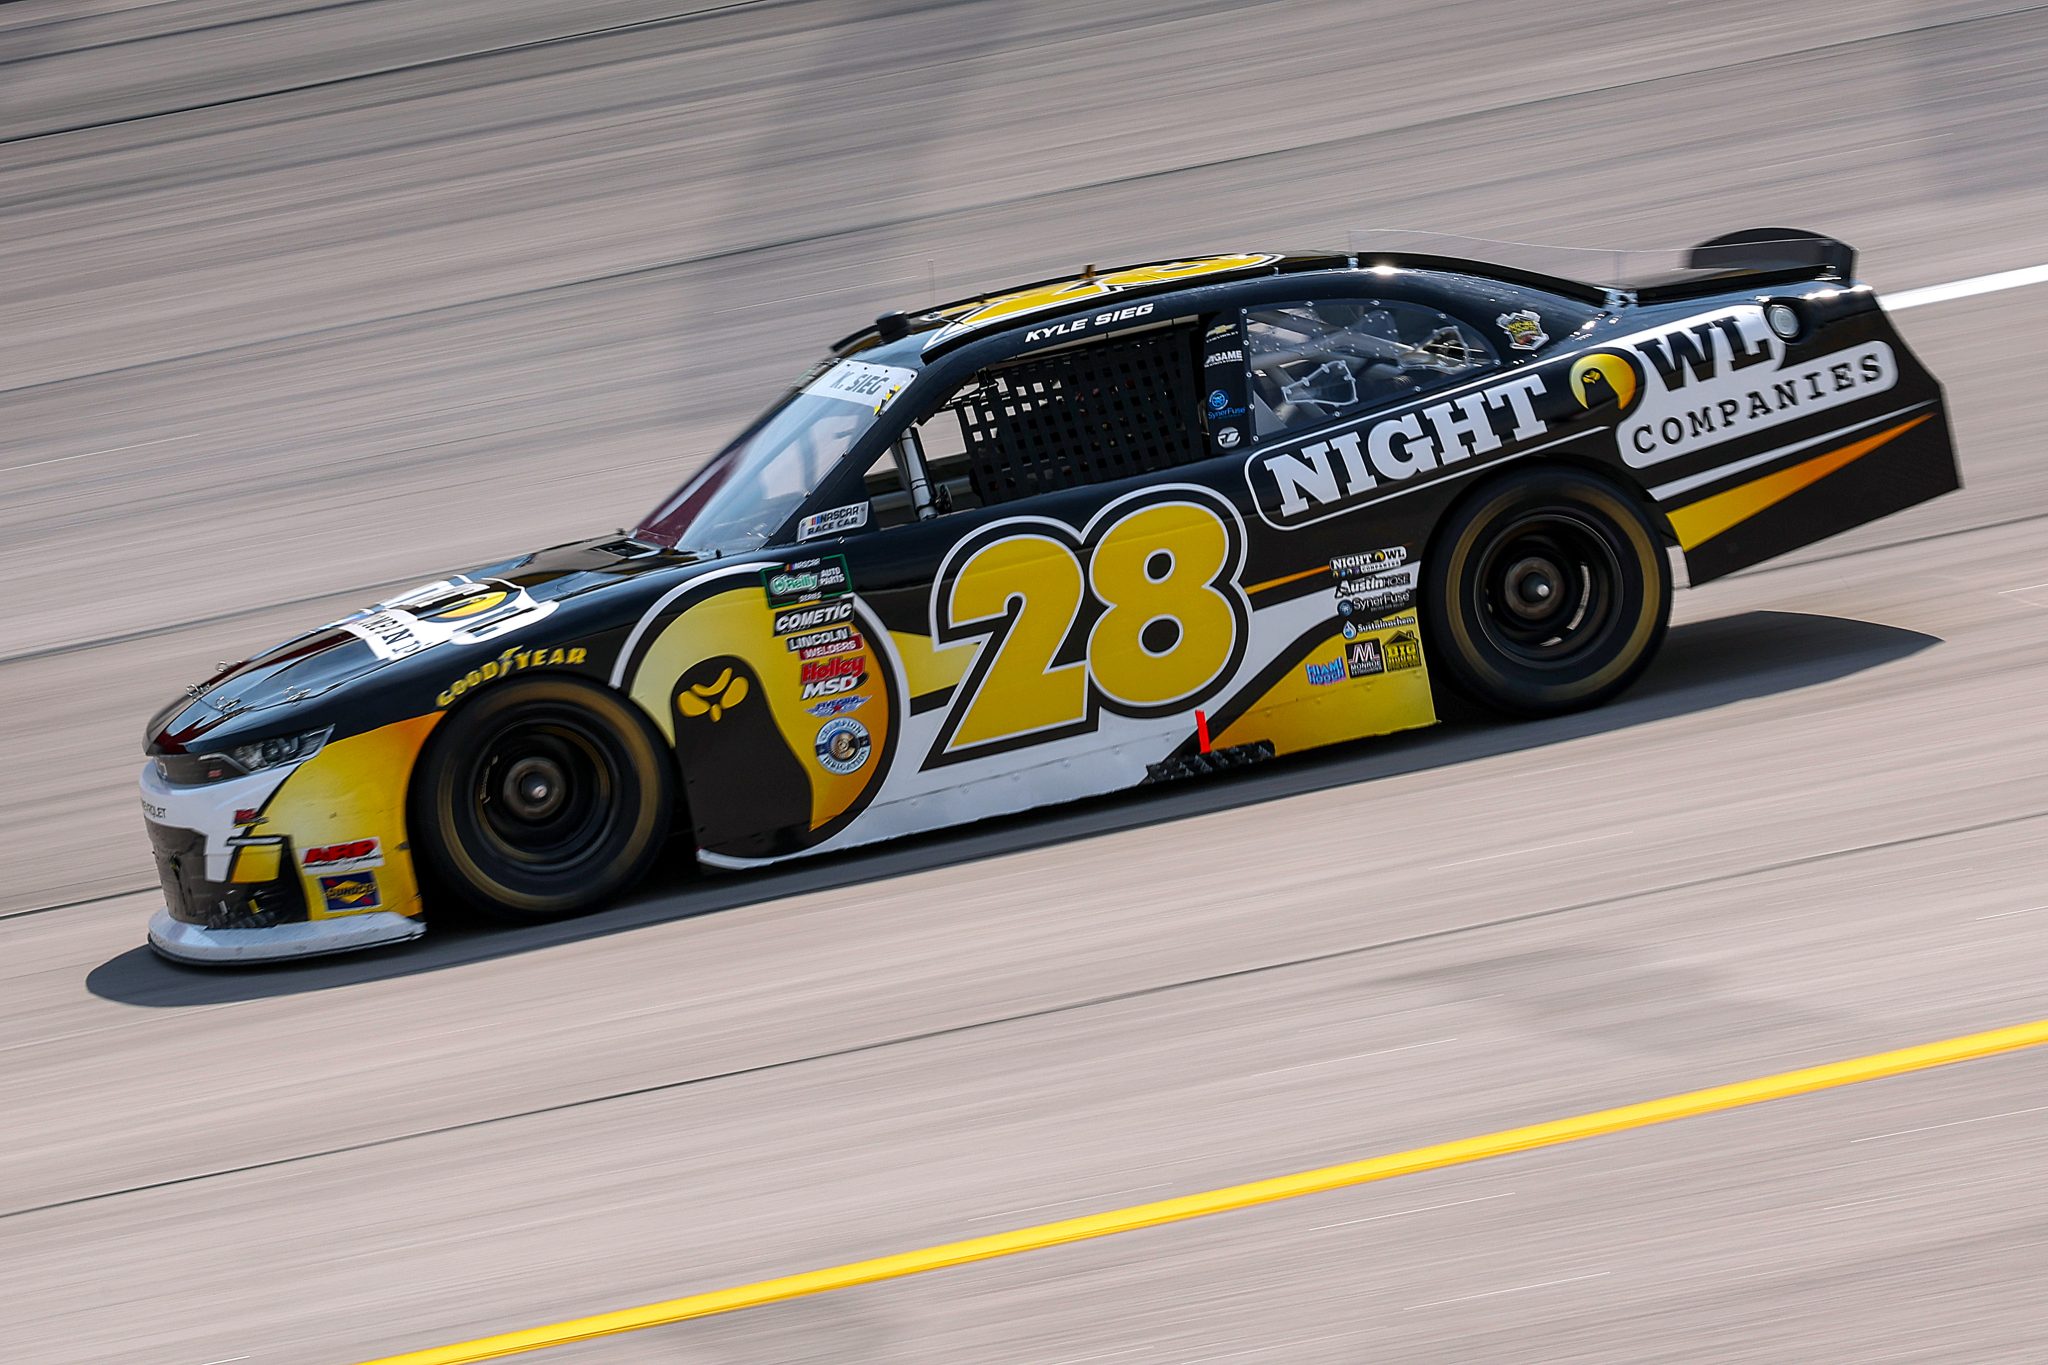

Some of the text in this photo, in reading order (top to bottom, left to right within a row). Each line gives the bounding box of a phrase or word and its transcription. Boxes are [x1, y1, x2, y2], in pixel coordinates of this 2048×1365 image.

[1025, 303, 1154, 343] KYLE SIEG
[844, 374, 890, 395] SIEG
[1633, 352, 1882, 454] COMPANIES
[1263, 373, 1548, 518] NIGHT
[820, 506, 859, 523] NASCAR
[807, 516, 857, 536] RACE CAR
[820, 566, 841, 577] AUTO
[1332, 553, 1372, 570] NIGHT
[820, 574, 845, 586] PARTS
[775, 603, 852, 632] COMETIC
[938, 490, 1244, 762] 28
[789, 627, 849, 650] LINCOLN
[804, 640, 857, 659] WELDERS
[1387, 642, 1416, 658] BIG
[801, 656, 866, 684] Holley
[1350, 660, 1382, 671] MONROE
[802, 675, 859, 700] MSD
